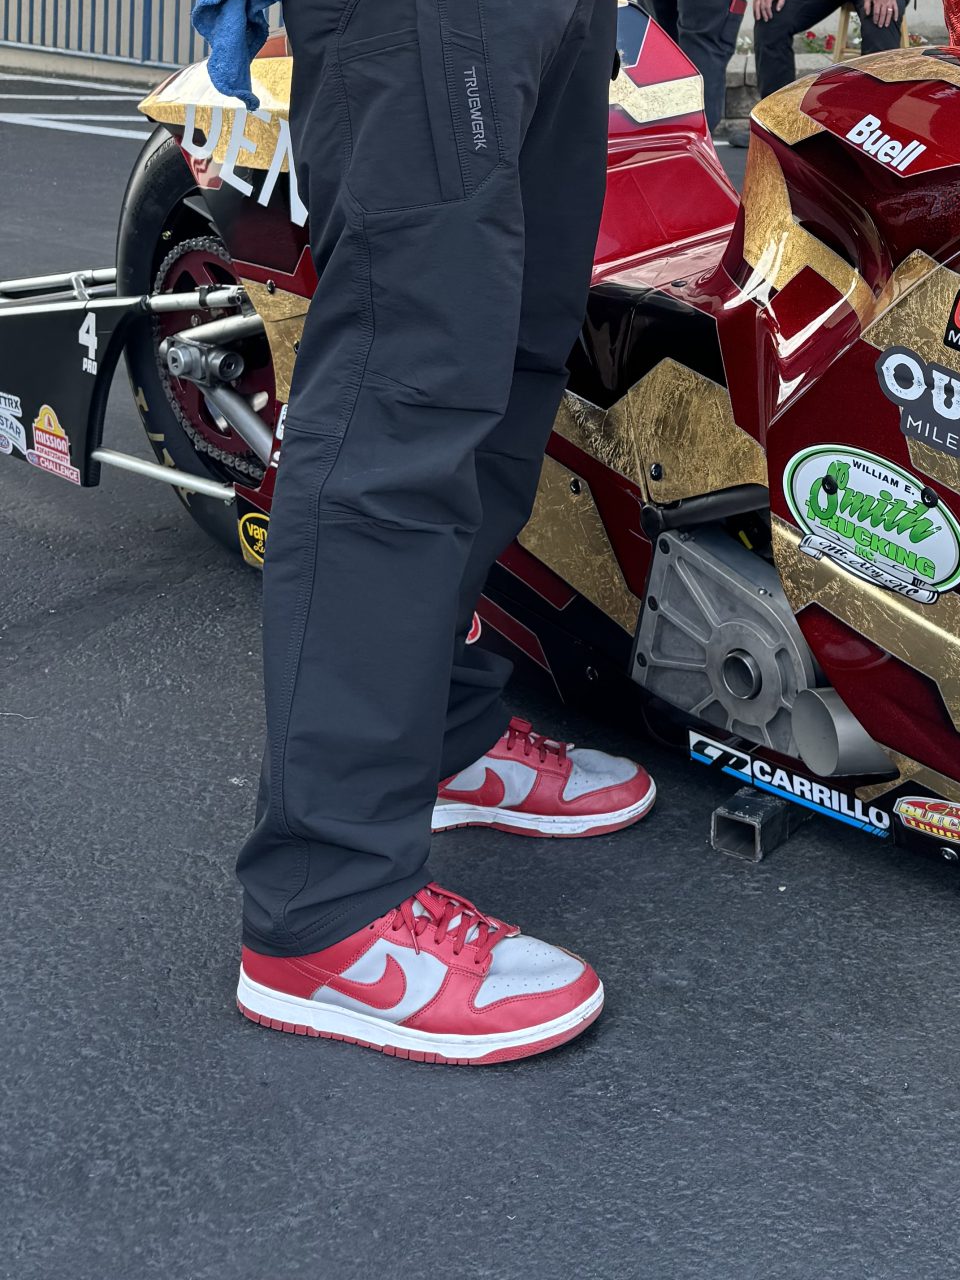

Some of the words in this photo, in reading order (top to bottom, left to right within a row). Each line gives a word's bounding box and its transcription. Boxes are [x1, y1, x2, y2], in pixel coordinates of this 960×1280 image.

[464, 65, 487, 151] TRUEWERK
[181, 103, 308, 228] DEN
[845, 113, 928, 172] Buell
[78, 311, 98, 361] 4
[82, 357, 98, 376] PRO
[36, 430, 67, 454] MISSION
[906, 414, 958, 450] MILE
[40, 457, 79, 481] CHALLENGE
[852, 459, 900, 488] WILLIAM
[904, 484, 915, 496] E.
[809, 460, 942, 544] Smith
[805, 499, 937, 580] TRUCKING
[819, 540, 847, 559] Mt.
[752, 759, 891, 830] CARRILLO
